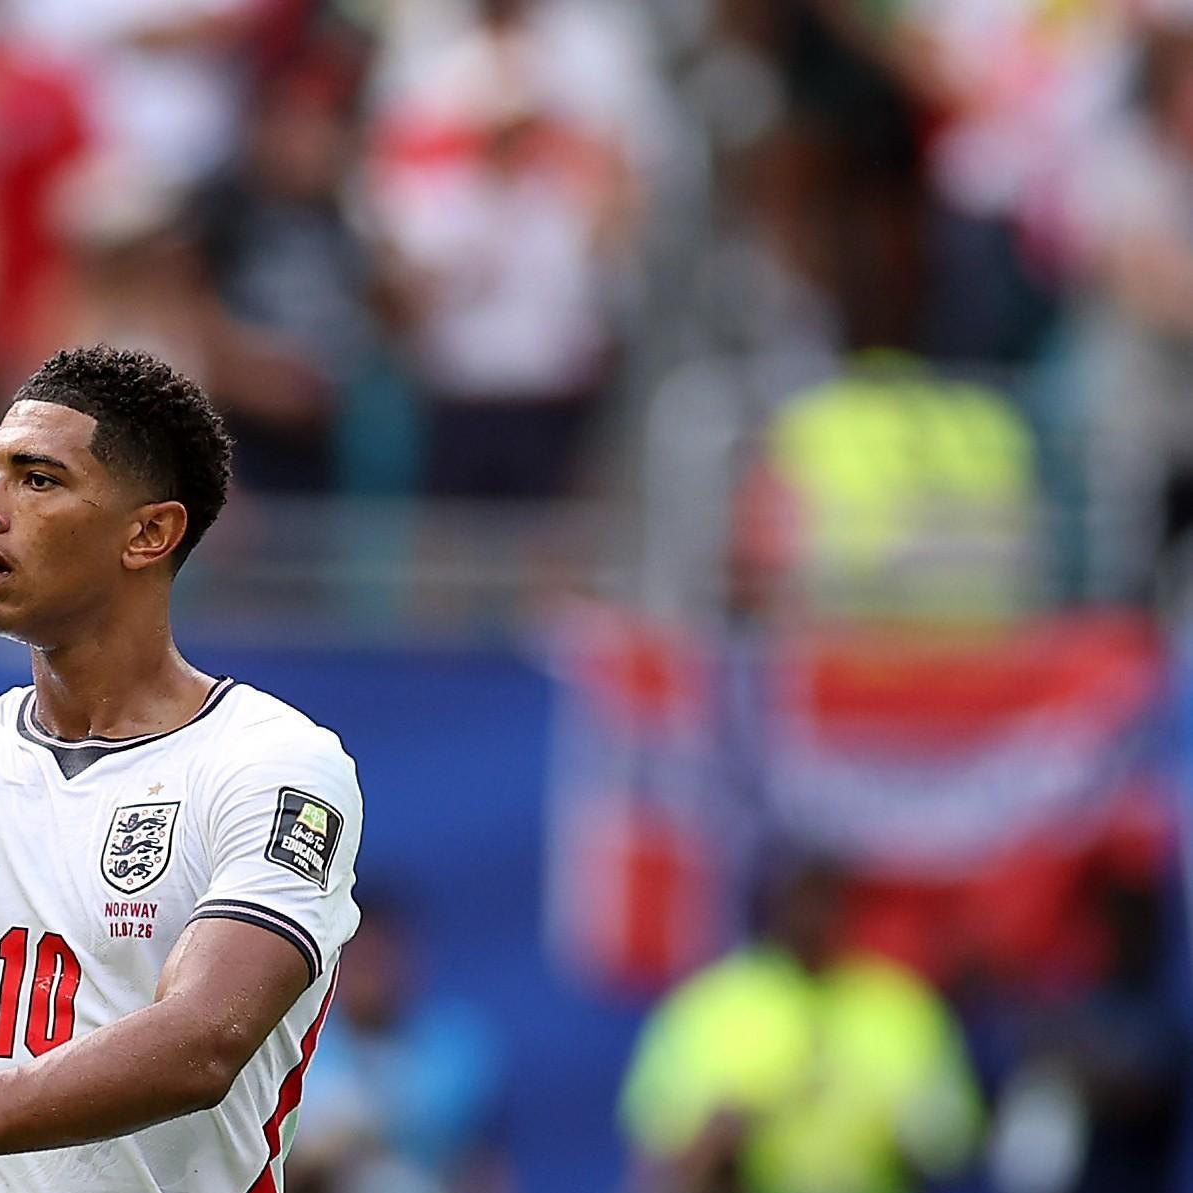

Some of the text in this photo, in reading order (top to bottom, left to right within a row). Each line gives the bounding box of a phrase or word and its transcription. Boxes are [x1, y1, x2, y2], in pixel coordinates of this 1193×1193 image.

[281, 835, 325, 872] EDUCATION
[105, 902, 158, 918] NORWAY
[110, 922, 153, 938] 11.07.26
